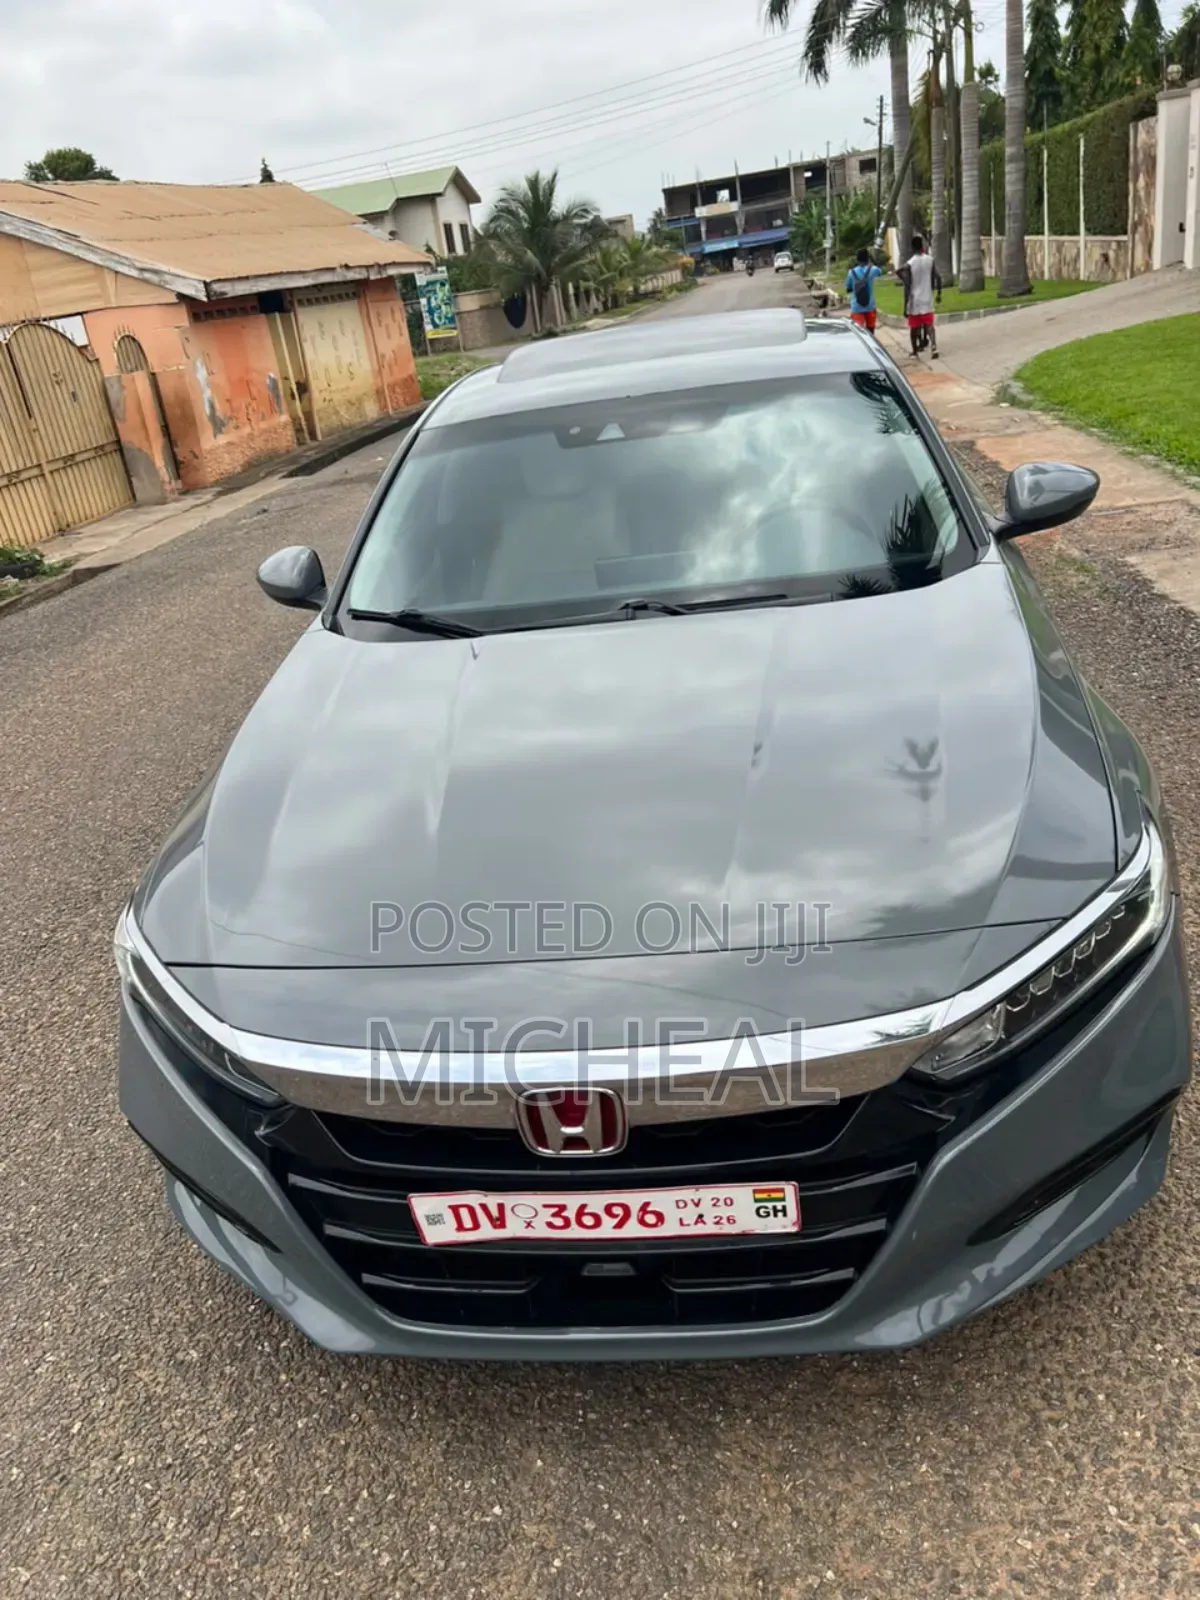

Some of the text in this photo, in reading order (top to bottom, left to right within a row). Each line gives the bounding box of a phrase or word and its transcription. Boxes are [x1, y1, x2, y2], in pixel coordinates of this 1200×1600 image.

[675, 1196, 735, 1209] DV 20
[447, 1202, 507, 1232] DV
[541, 1201, 665, 1231] 3696
[755, 1205, 788, 1219] GH
[678, 1213, 737, 1227] LA 26
